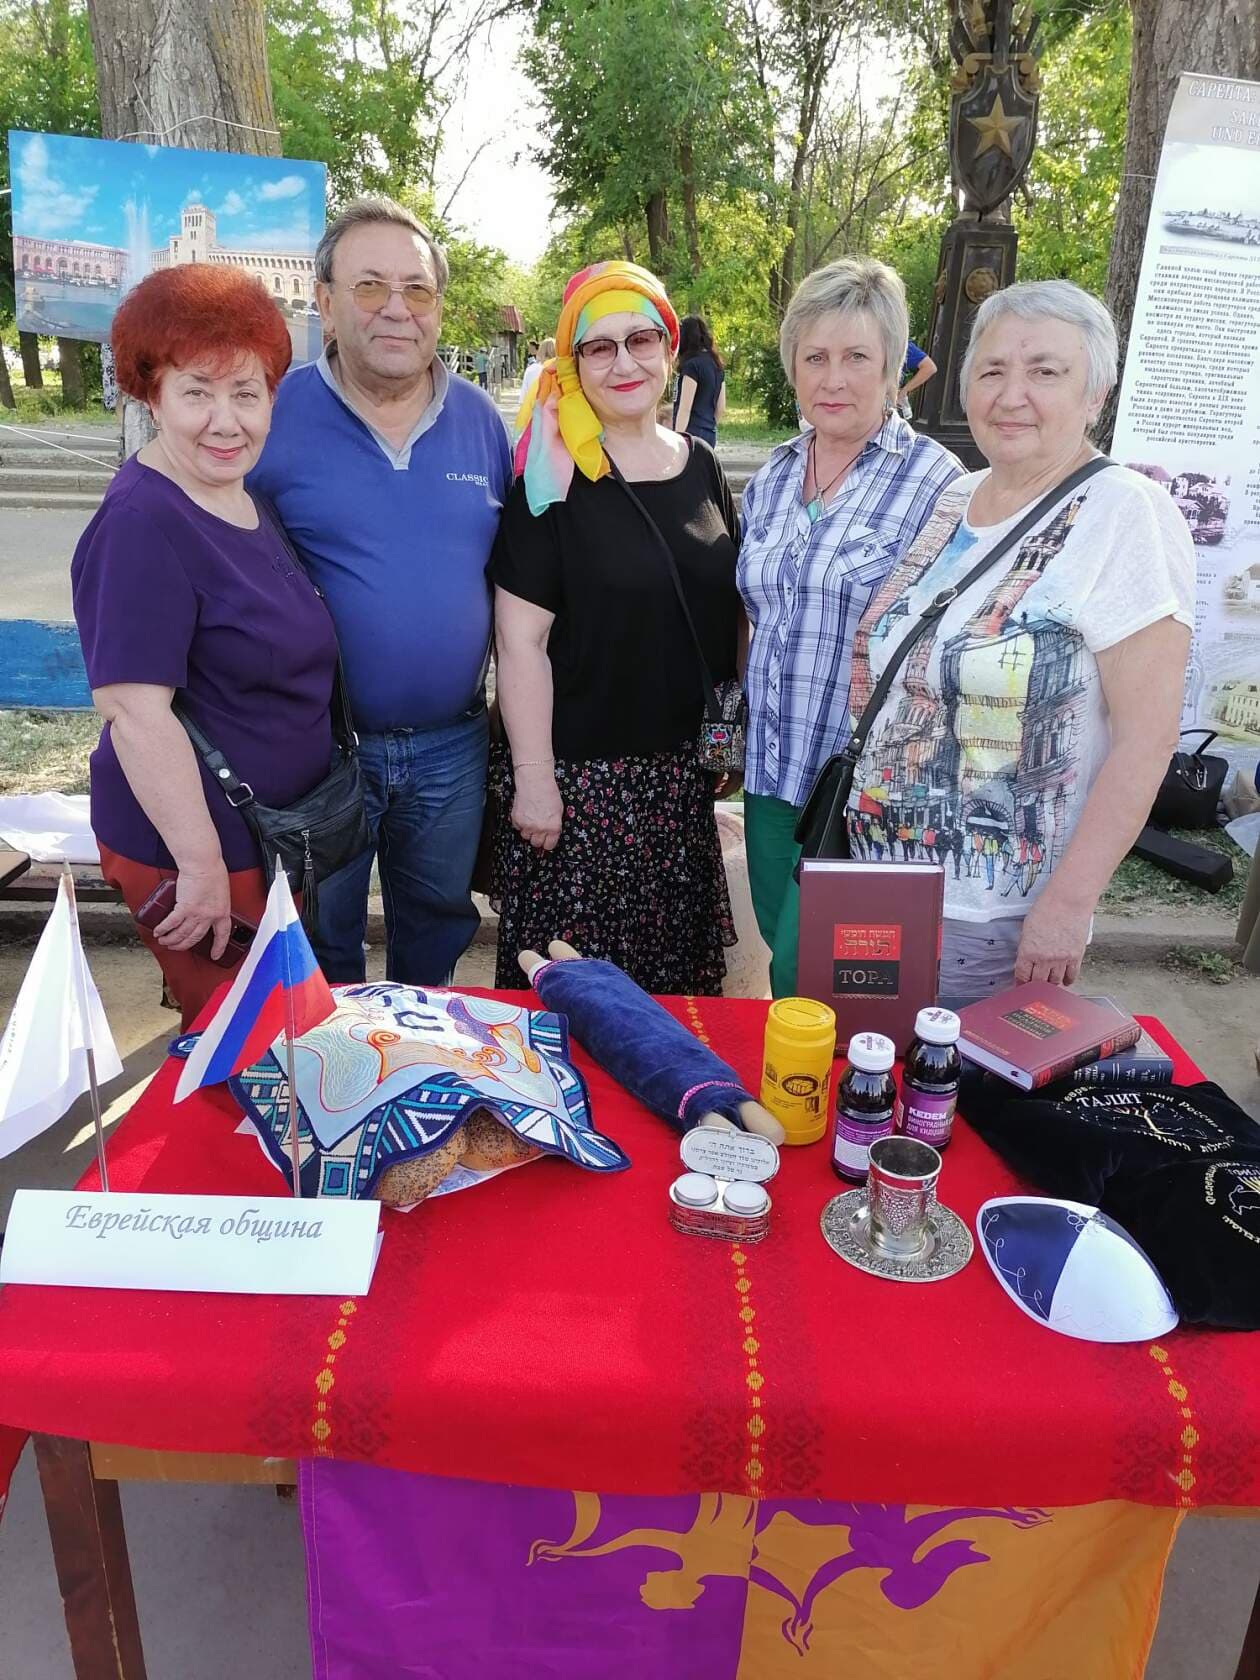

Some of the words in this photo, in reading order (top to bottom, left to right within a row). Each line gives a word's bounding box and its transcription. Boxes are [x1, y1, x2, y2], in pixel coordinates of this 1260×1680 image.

[446, 473, 489, 484] CLASSIC
[1076, 1093, 1142, 1108] ТАЛИТ
[65, 1205, 212, 1239] Еврейская
[219, 1209, 323, 1244] община
